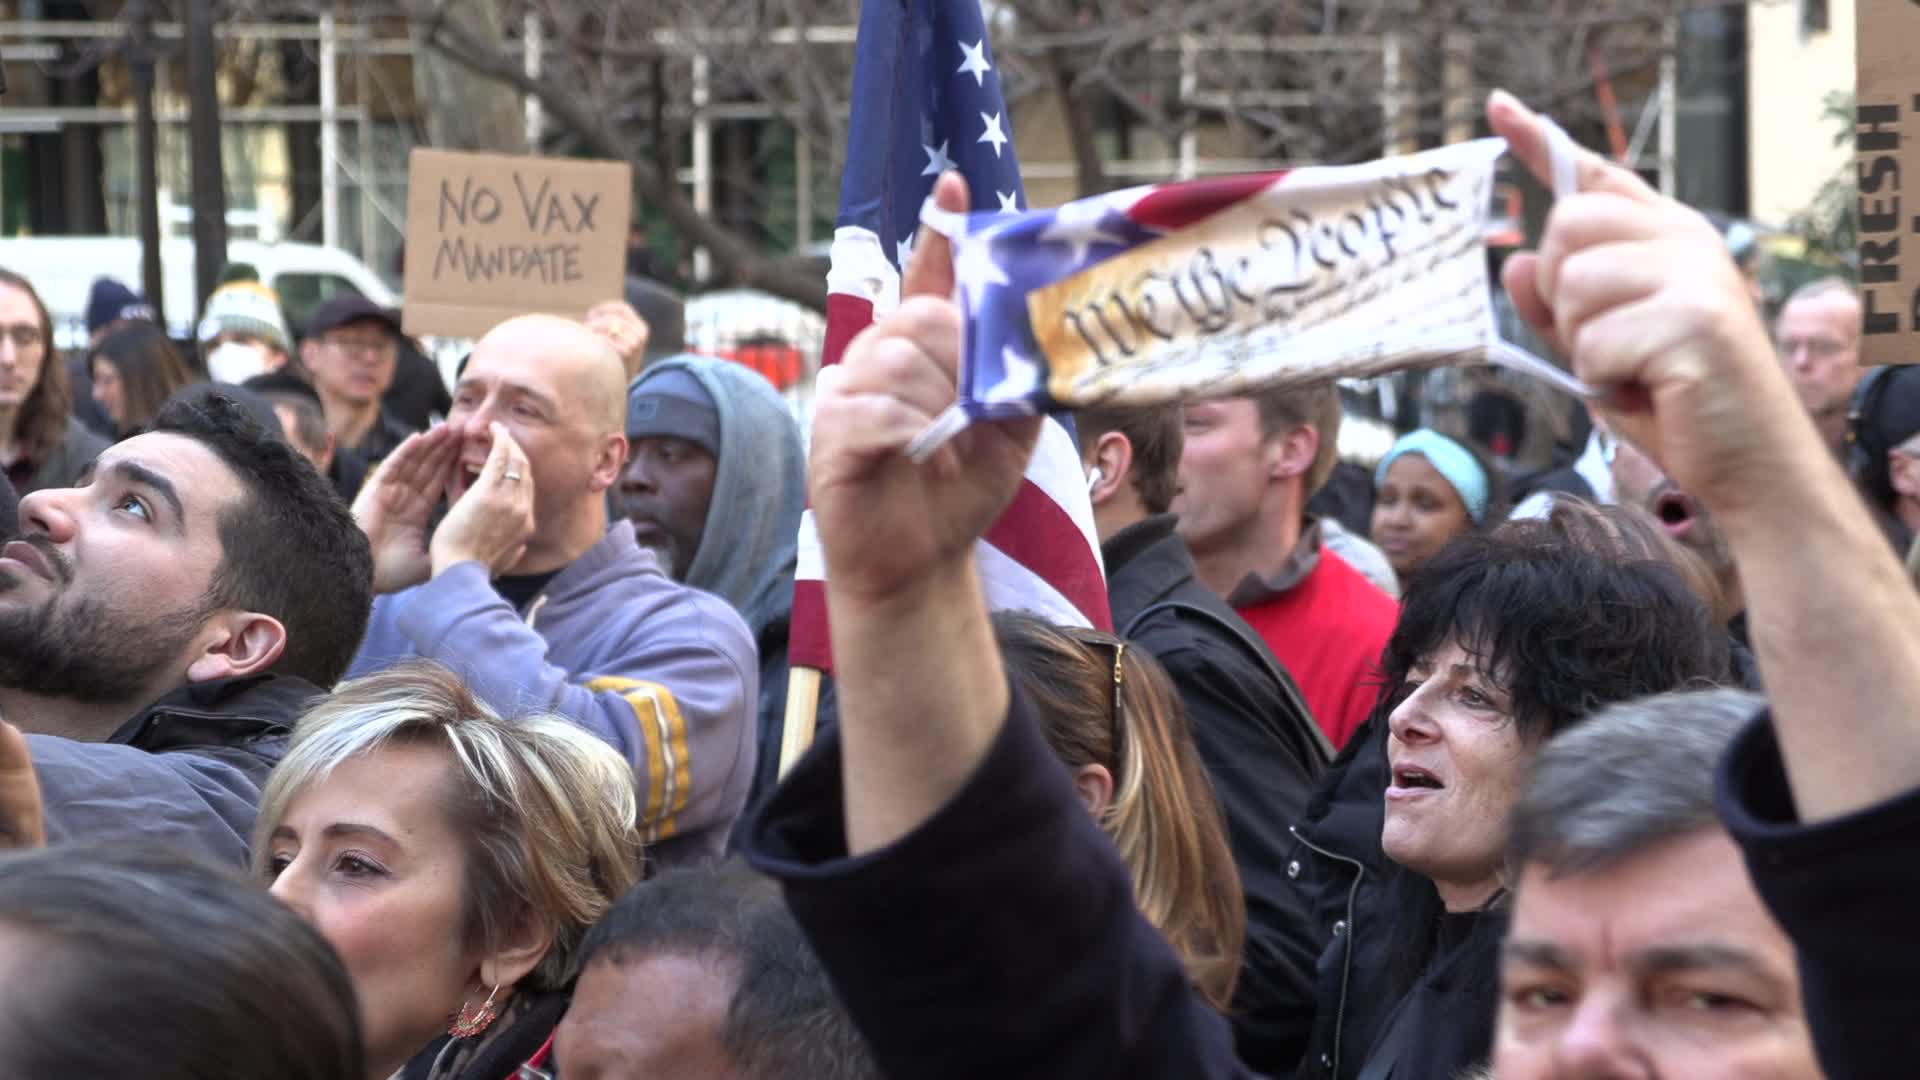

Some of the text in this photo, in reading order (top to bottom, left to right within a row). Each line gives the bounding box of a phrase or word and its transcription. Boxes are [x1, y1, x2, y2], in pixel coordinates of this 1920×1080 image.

[432, 235, 583, 285] MANDATE
[438, 170, 601, 236] NO VAX
[1064, 270, 1175, 367] We
[1257, 167, 1460, 297] People
[1857, 105, 1899, 334] FRESH
